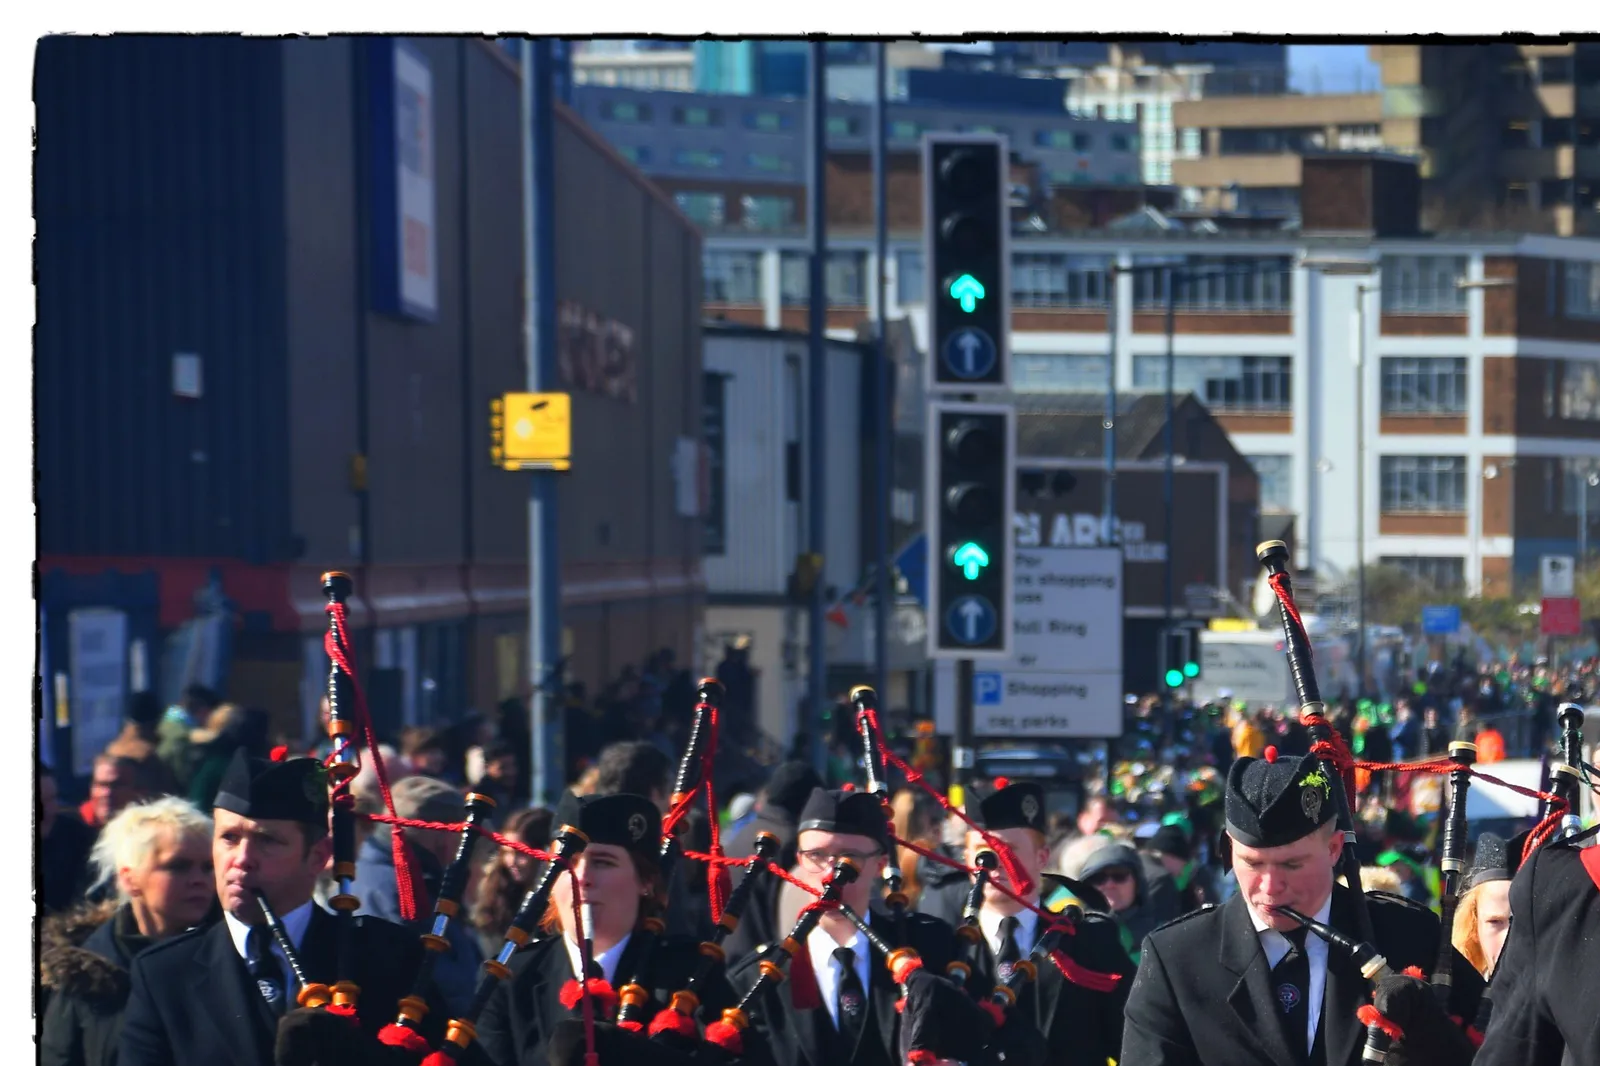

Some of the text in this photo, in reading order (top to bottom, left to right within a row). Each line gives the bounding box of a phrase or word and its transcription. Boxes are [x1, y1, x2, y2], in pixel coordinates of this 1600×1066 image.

[1039, 573, 1115, 589] shopping
[1049, 620, 1088, 637] Ring
[980, 676, 1088, 704] P Shopping
[988, 713, 1069, 730] car parks
